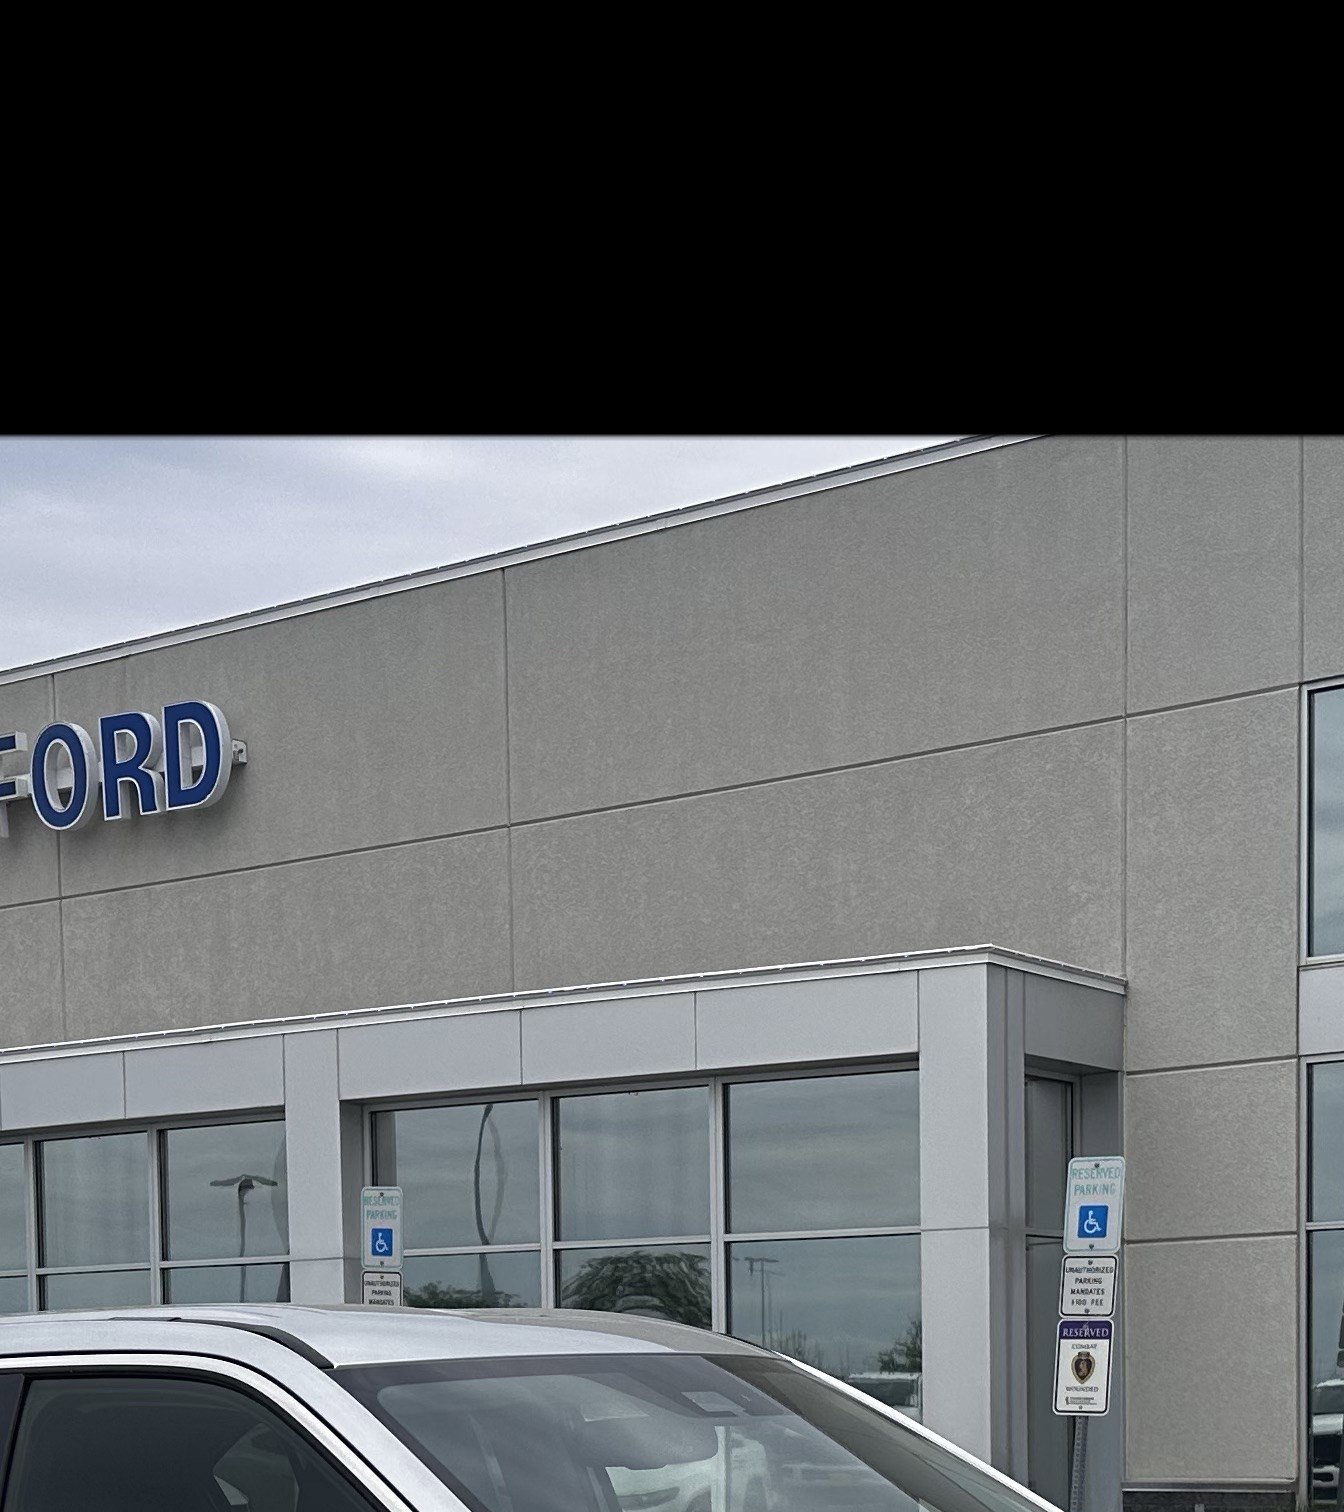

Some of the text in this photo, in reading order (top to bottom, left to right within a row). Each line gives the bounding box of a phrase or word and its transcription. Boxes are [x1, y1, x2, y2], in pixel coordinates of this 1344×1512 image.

[1070, 1167, 1120, 1179] RESERVED
[1074, 1183, 1115, 1196] PARKING
[1065, 1266, 1114, 1274] UNAUTHORIZED
[1062, 1327, 1109, 1338] RESERVED
